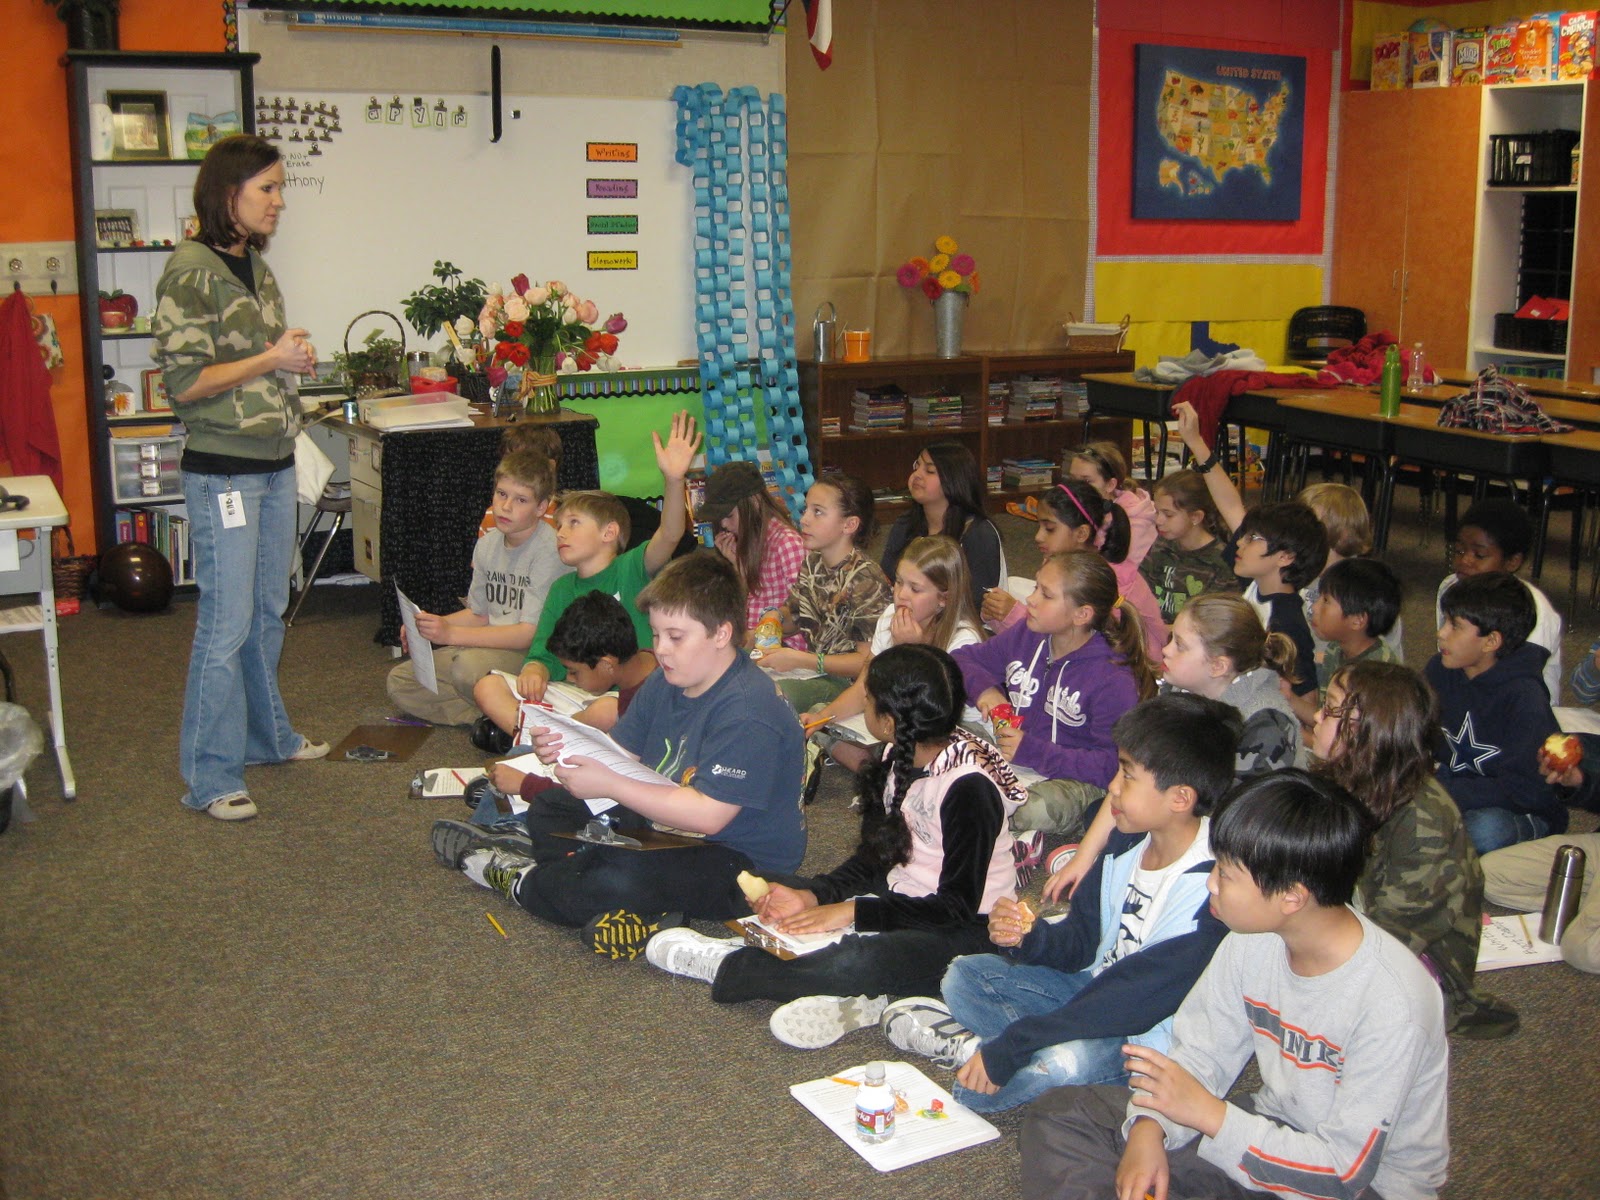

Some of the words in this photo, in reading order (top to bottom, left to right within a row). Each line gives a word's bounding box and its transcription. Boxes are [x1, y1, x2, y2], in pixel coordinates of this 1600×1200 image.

[1561, 19, 1595, 37] CRUNCH
[1216, 65, 1249, 78] UNITED
[1250, 68, 1281, 81] STATES
[595, 147, 631, 159] Writing
[595, 183, 629, 194] Reading
[593, 256, 632, 266] Homework
